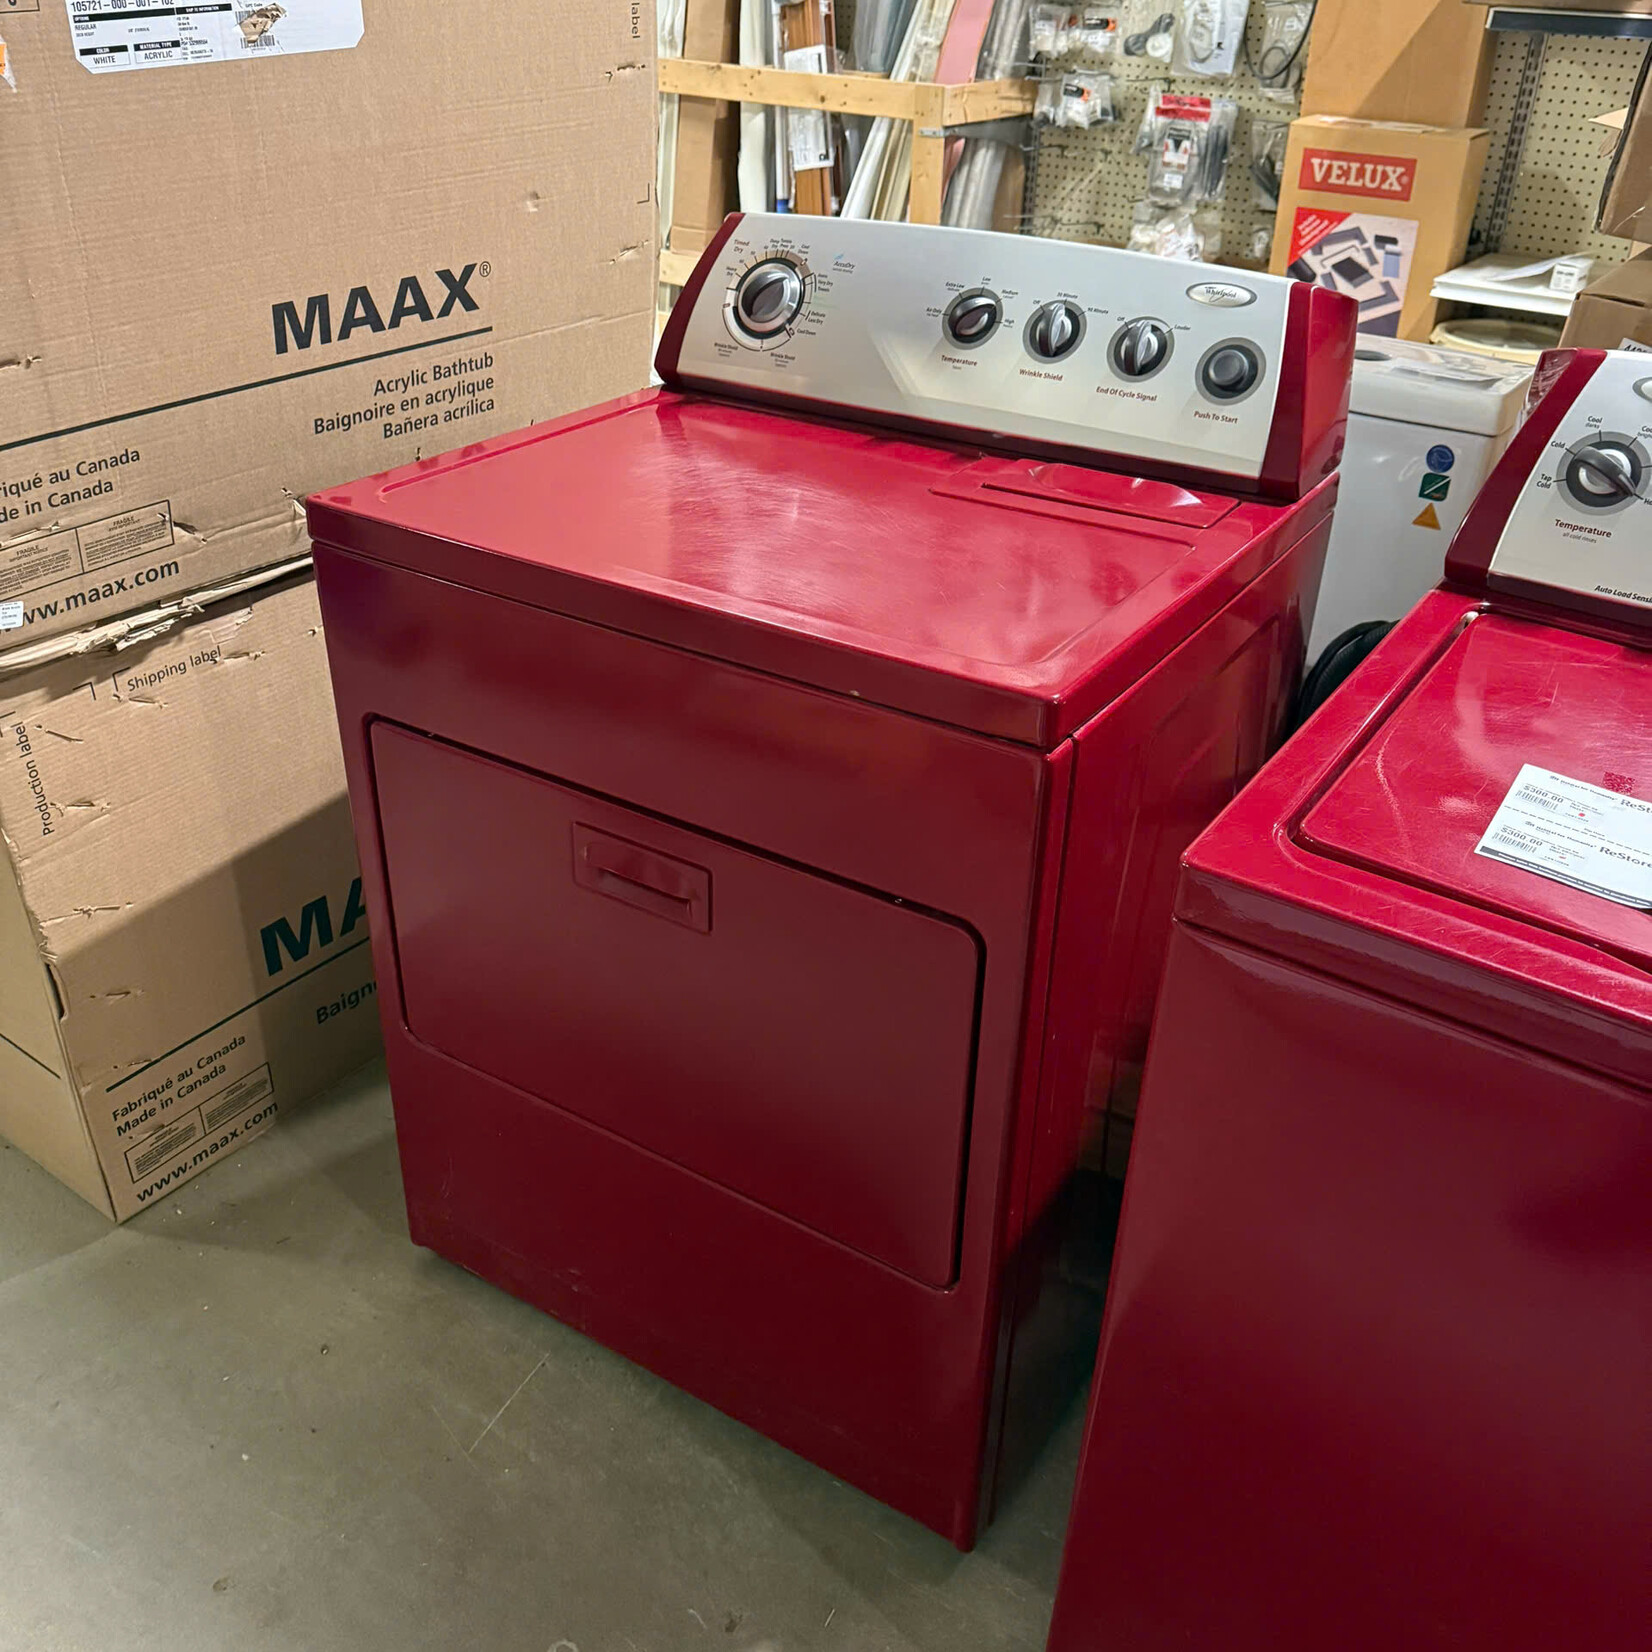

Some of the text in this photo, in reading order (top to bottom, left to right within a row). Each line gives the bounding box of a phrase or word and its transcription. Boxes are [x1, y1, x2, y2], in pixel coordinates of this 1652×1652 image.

[631, 2, 641, 39] label
[93, 55, 116, 65] WHITE
[144, 50, 173, 61] ACRYLIC
[1310, 158, 1406, 192] VELUX
[734, 246, 744, 254] Dry
[1204, 286, 1238, 302] Whirlpool
[941, 354, 978, 366] Temperature
[374, 352, 494, 396] Acrylic Bathtub
[1020, 368, 1064, 382] Wrinkle Shield
[1096, 386, 1109, 394] End
[1118, 389, 1136, 399] Cycle
[1136, 392, 1158, 402] Signal
[314, 376, 495, 435] Baignoire en acrylique
[383, 398, 495, 440] Bañera acrílica
[1193, 410, 1238, 424] Push To Start
[1588, 416, 1604, 424] Cool
[1550, 440, 1566, 449] Cold
[49, 468, 70, 485] au
[76, 448, 141, 477] Canada
[1536, 480, 1552, 490] Cold
[1541, 474, 1552, 483] Tap
[25, 500, 42, 516] in
[48, 479, 114, 508] Canada
[113, 516, 135, 527] FRAGILE
[1554, 518, 1612, 538] Temperature
[16, 544, 39, 556] FRAGILE
[1594, 585, 1612, 595] Auto
[1613, 589, 1632, 600] Load
[127, 644, 222, 692] Shipping label
[12, 721, 56, 836] Production label
[1523, 785, 1564, 803] $300.00
[1620, 799, 1652, 815] ReSt
[1500, 826, 1543, 847] $300.00
[112, 1076, 173, 1122] Fabriqué
[177, 1068, 194, 1083] au
[196, 1035, 246, 1069] Canada
[116, 1108, 157, 1137] Made
[160, 1096, 174, 1110] in
[177, 1062, 227, 1099] Canada
[136, 1102, 278, 1202] www.maax.com
